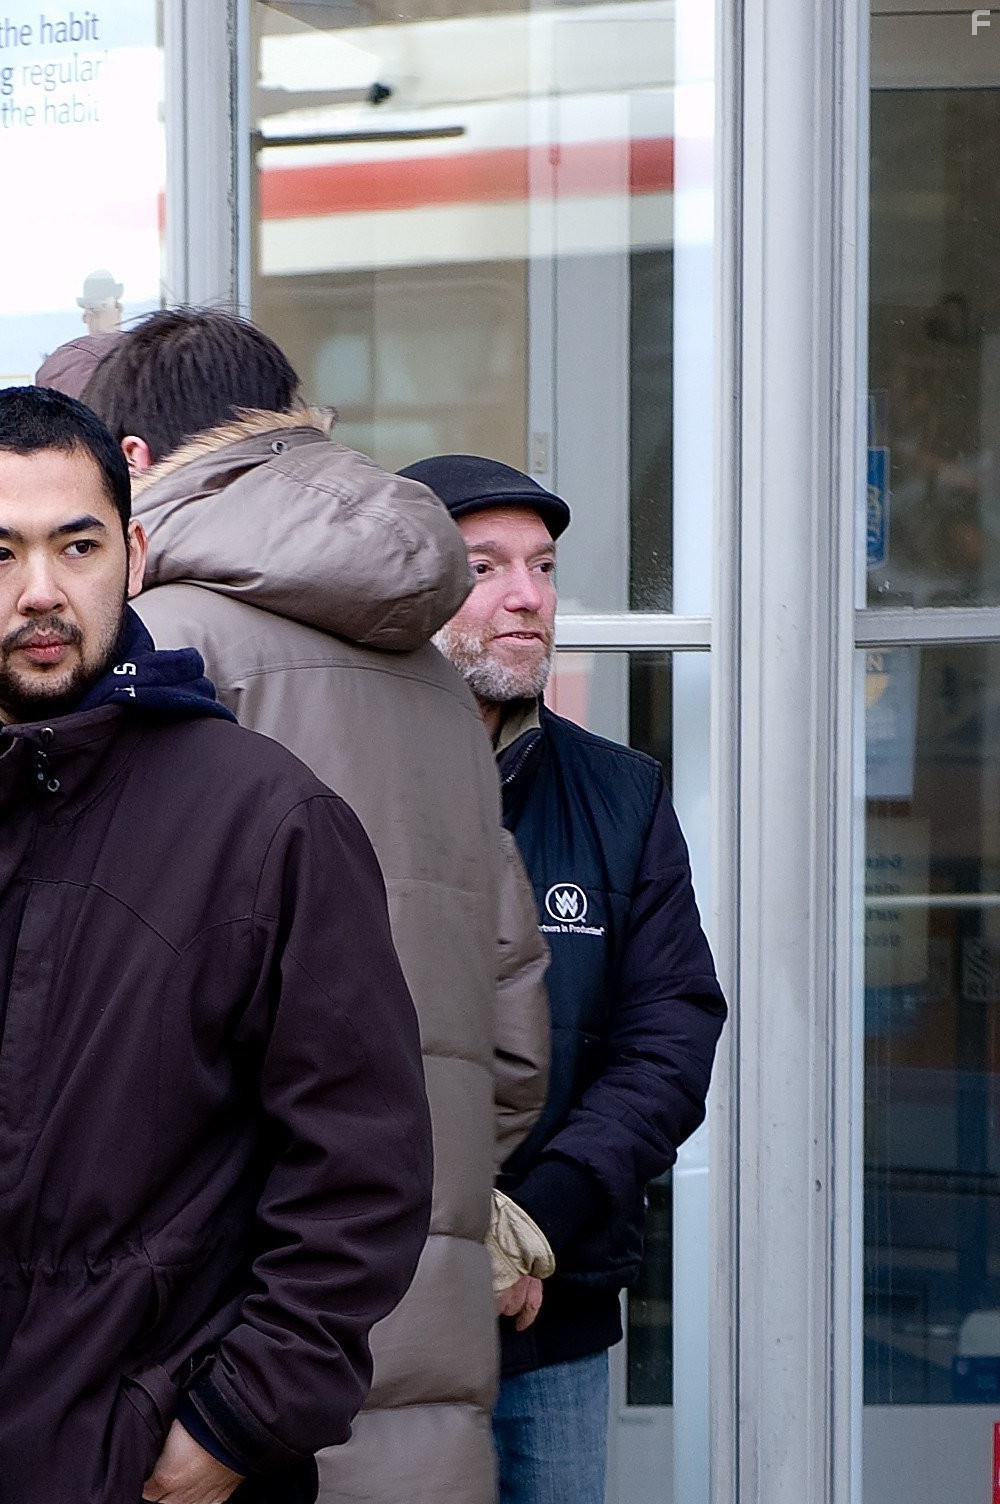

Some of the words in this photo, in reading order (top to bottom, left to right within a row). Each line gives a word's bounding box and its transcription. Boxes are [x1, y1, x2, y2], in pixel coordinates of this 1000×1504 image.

[40, 11, 100, 45] habit
[21, 50, 109, 92] regular
[1, 98, 37, 129] the
[44, 94, 100, 126] habit
